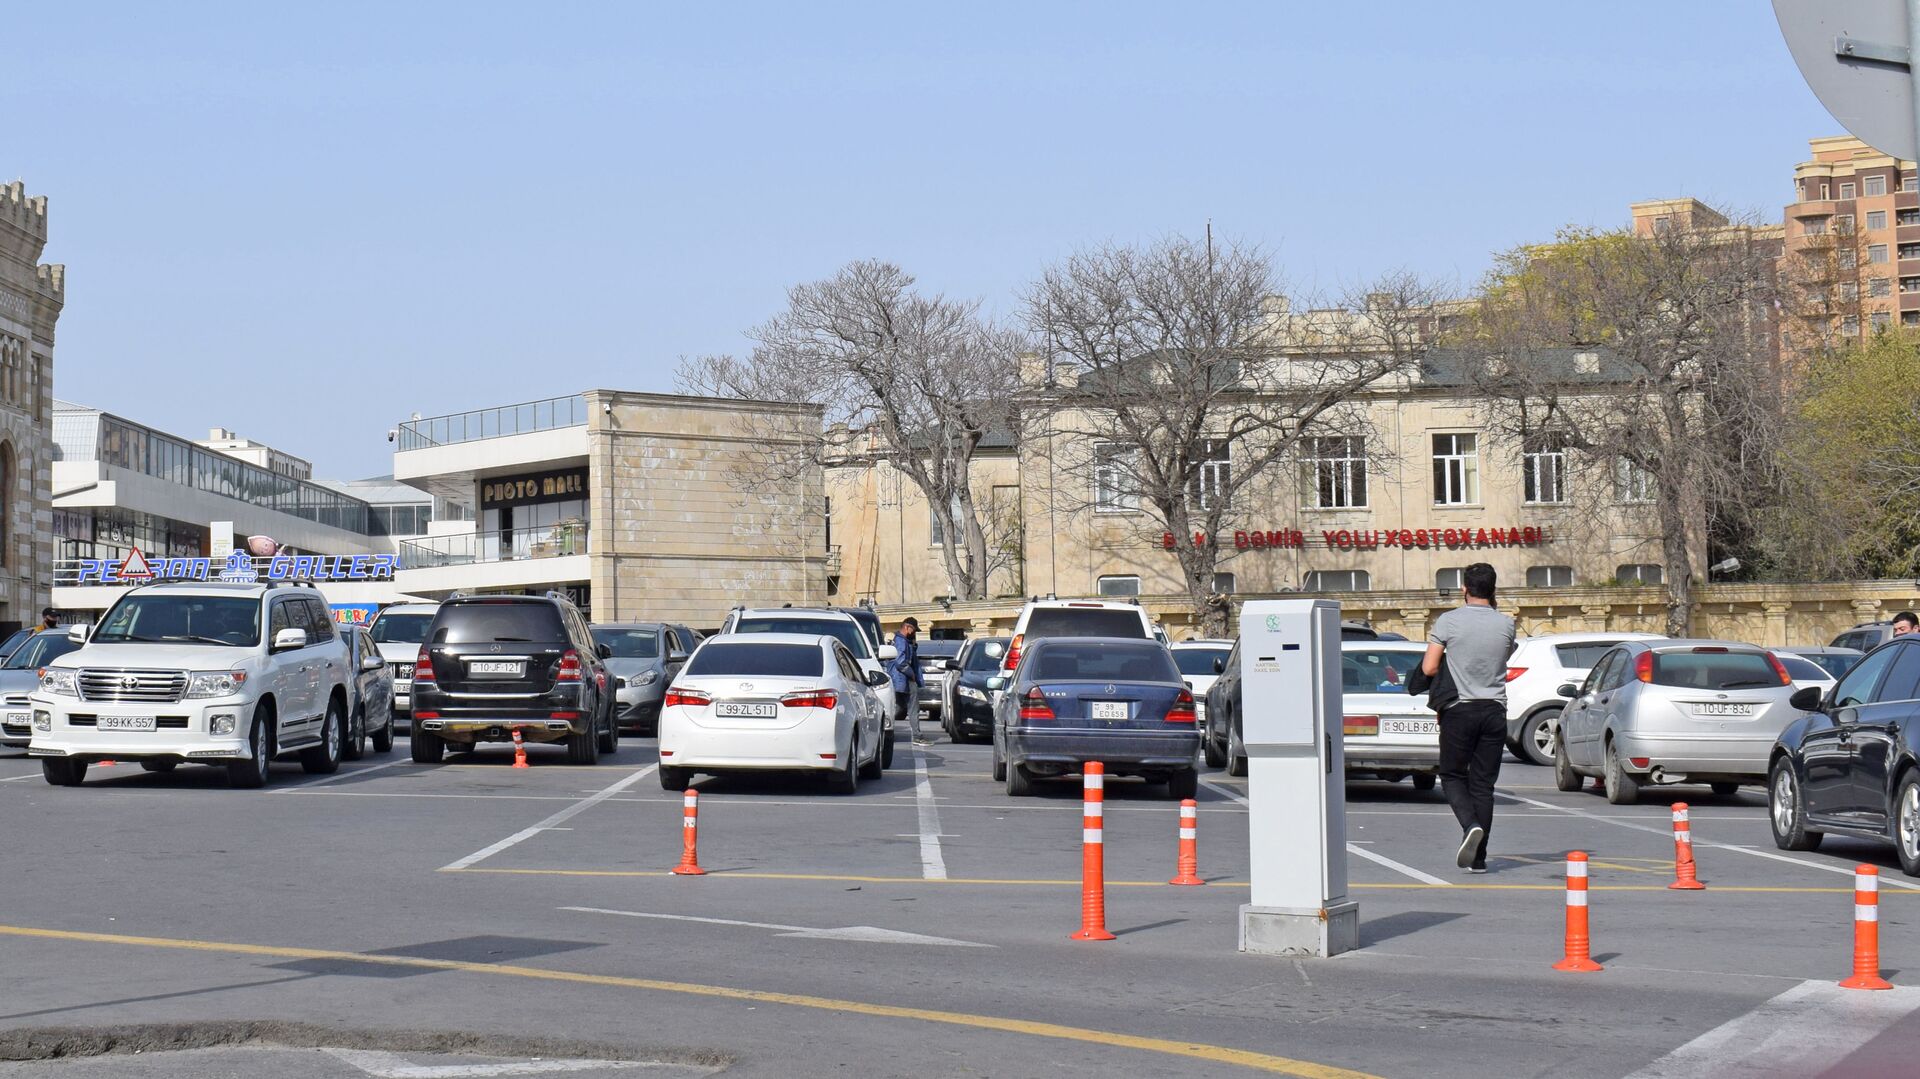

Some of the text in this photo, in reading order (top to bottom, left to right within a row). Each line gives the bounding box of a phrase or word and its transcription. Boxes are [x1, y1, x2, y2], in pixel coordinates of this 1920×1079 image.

[484, 475, 582, 502] PHOTO MALL
[1322, 530, 1378, 546] YOLU
[78, 555, 400, 583] PERON GALLER
[336, 608, 368, 623] JERRY
[726, 703, 773, 715] 99-ZL-511
[106, 714, 154, 728] 99-KK-557
[1392, 721, 1440, 732] 90-LB-870
